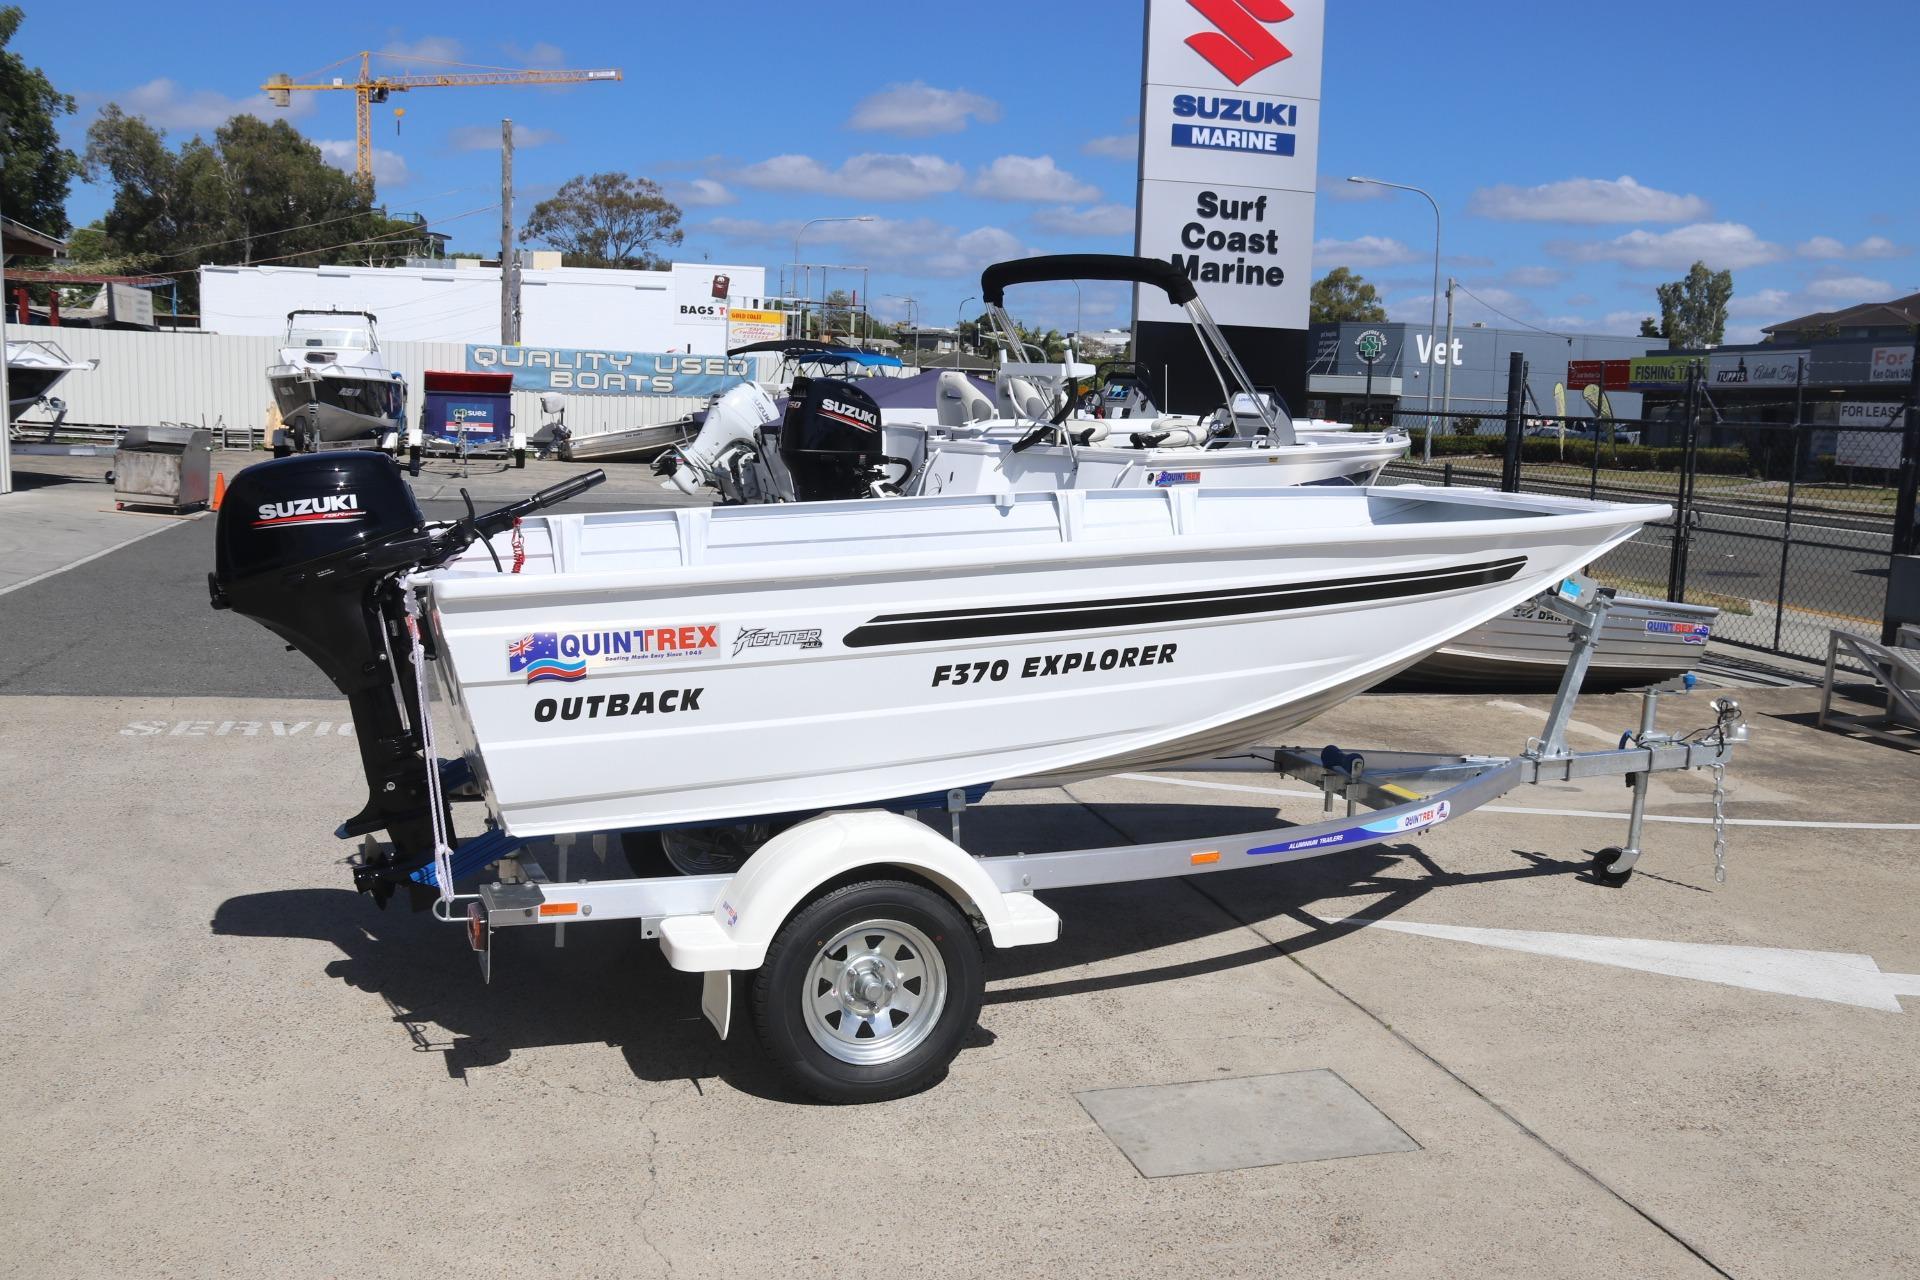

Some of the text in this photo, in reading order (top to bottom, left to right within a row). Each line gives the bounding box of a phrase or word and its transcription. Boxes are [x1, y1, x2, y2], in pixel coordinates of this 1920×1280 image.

[1172, 95, 1297, 126] SUZUKI
[1191, 127, 1277, 151] MARINE
[1196, 190, 1267, 222] Surf
[1181, 222, 1279, 255] Coast
[1171, 253, 1285, 287] Marine
[680, 305, 714, 315] BAGS
[473, 346, 750, 377] QUALITY USED
[1416, 334, 1463, 366] Vet
[1873, 350, 1908, 366] For
[549, 370, 674, 394] BOATS
[1635, 365, 1676, 380] FISHING
[1717, 371, 1746, 382] TUPPYS
[821, 398, 877, 426] SUZUKI
[1841, 405, 1903, 419] FOR LEASE
[258, 494, 359, 521] SUZUKI
[1647, 620, 1694, 634] QUINTREX
[560, 624, 720, 658] QUINTREX
[931, 643, 1178, 687] F370 EXPLORER
[534, 687, 705, 723] OUTBACK
[1404, 809, 1435, 827] QUINTREX
[1288, 834, 1344, 850] ALUMINIUM TRAILERS
